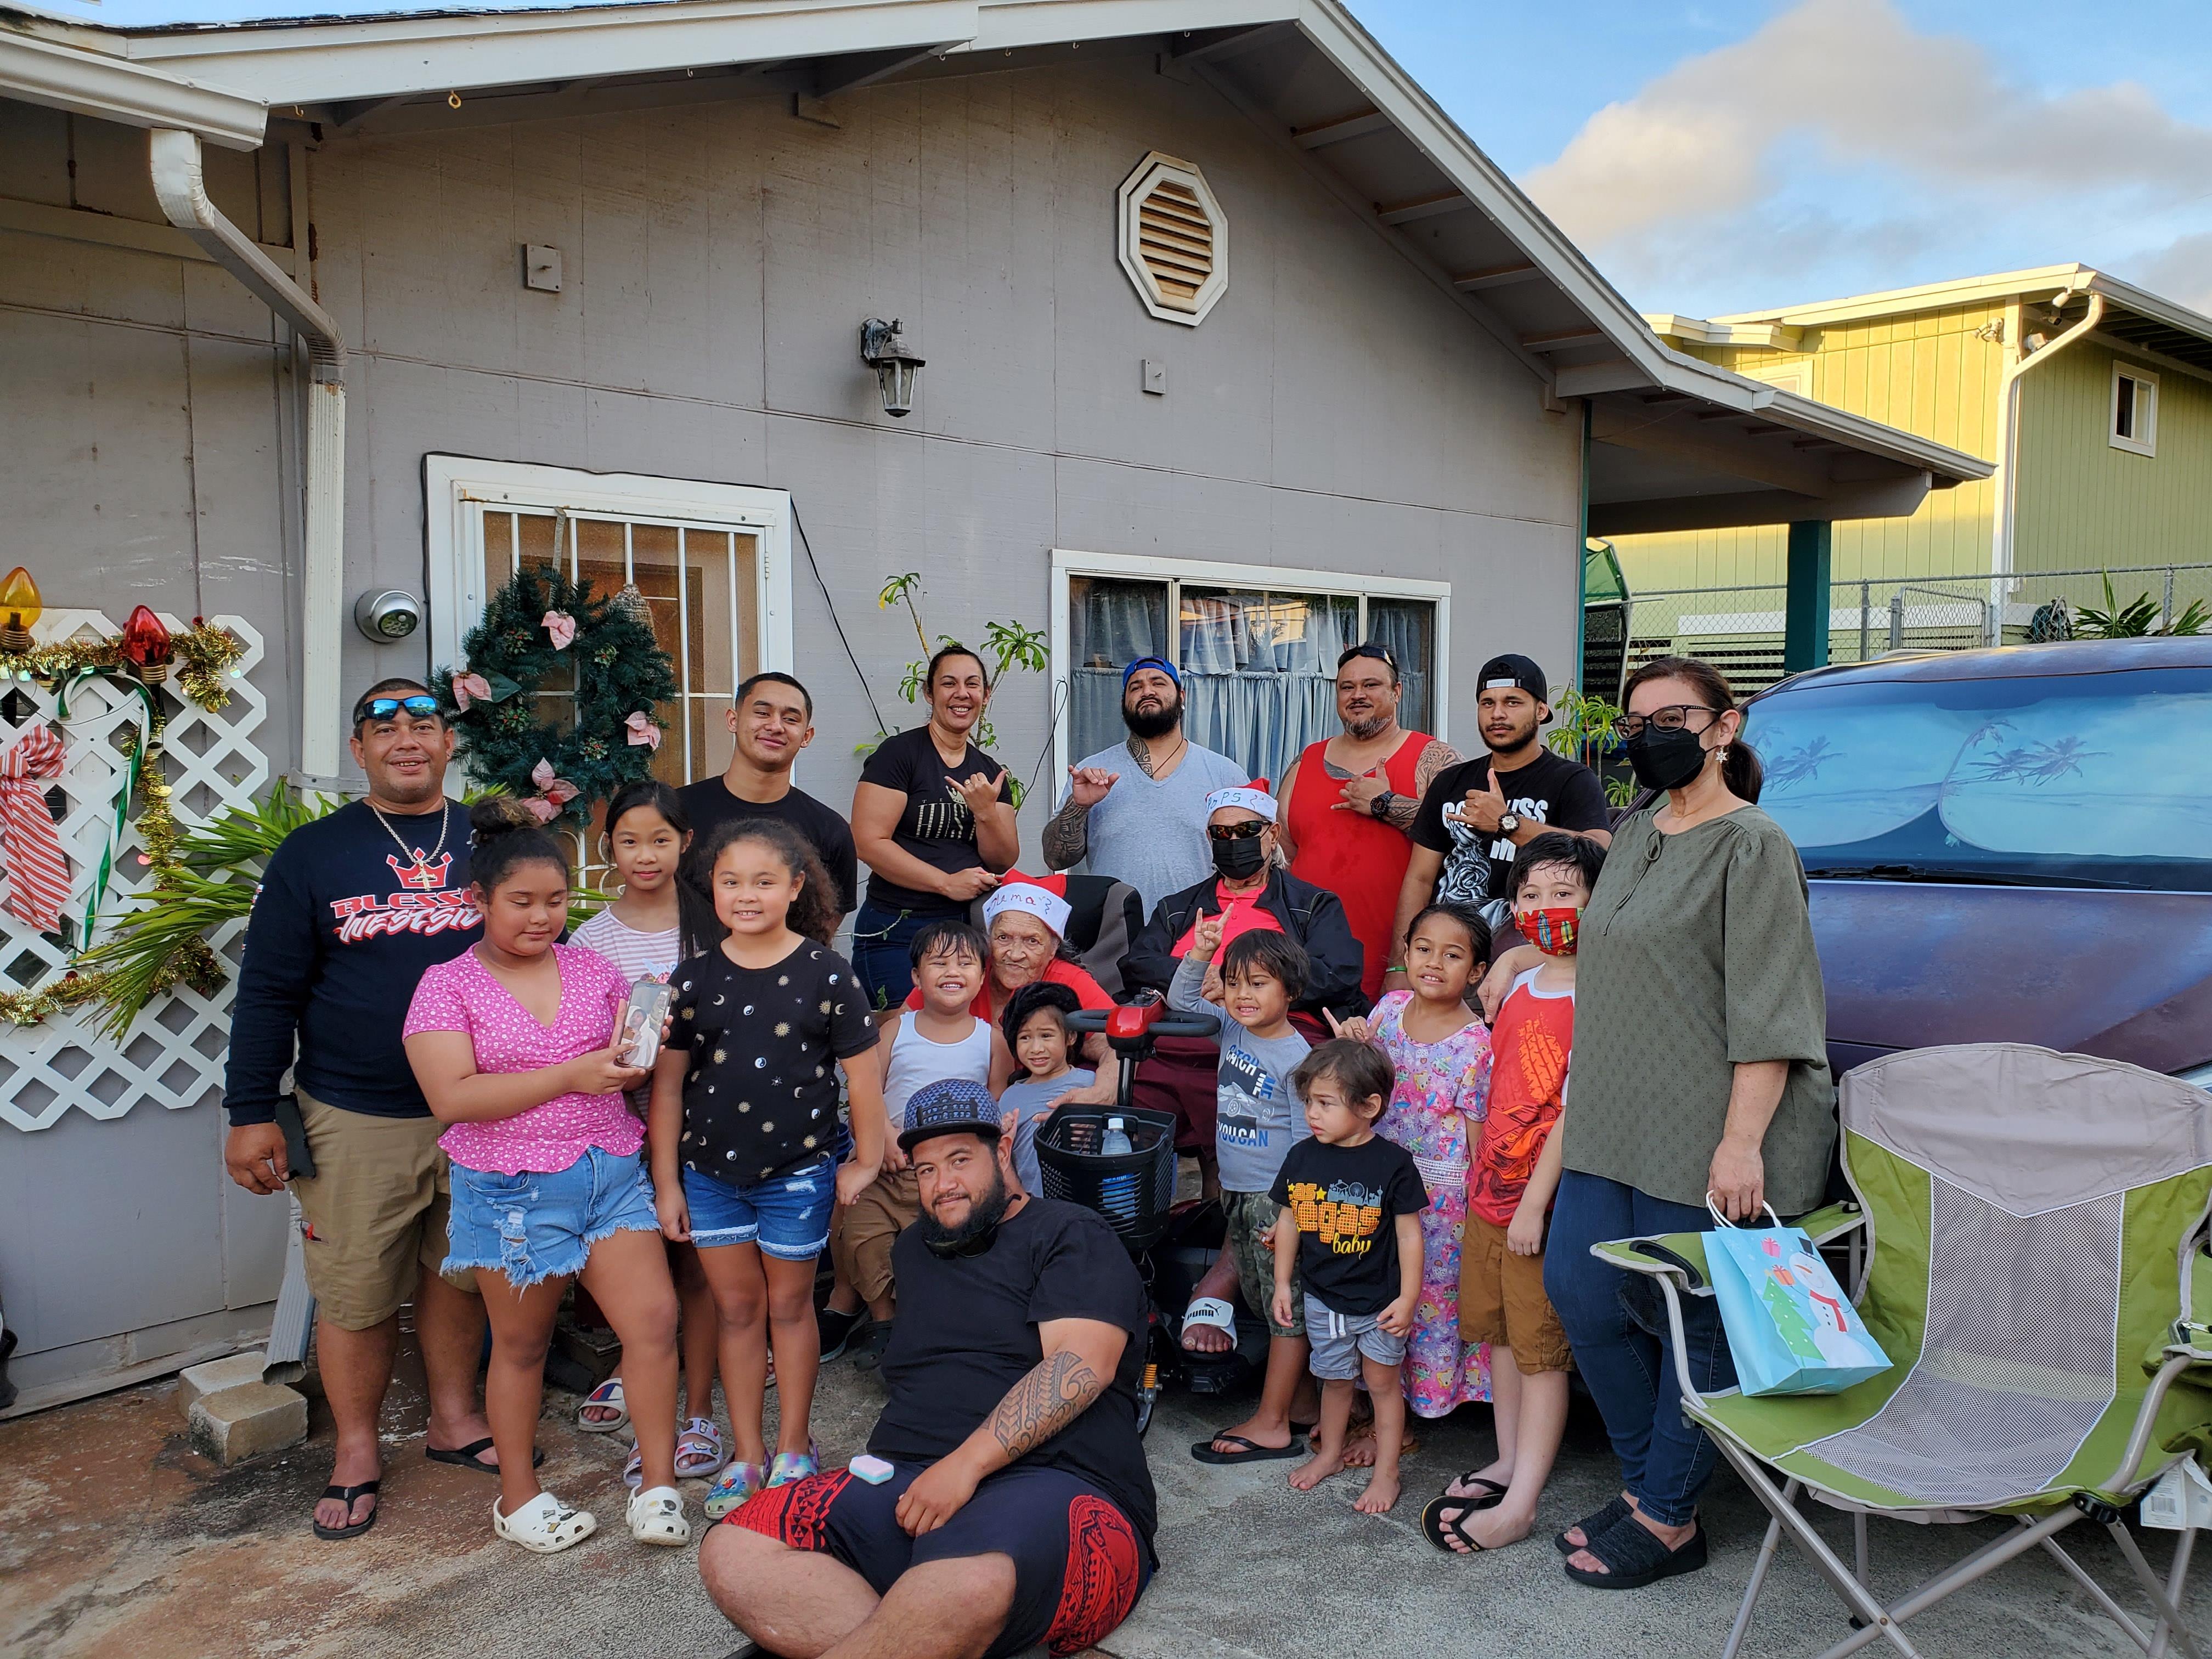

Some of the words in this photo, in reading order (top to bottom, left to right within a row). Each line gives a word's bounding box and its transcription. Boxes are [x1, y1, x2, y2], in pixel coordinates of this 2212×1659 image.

[1226, 1044, 1260, 1076] CATCH
[1252, 1073, 1277, 1100] ME
[1218, 1121, 1237, 1143] YOU
[1238, 1128, 1268, 1147] CAN
[1333, 1232, 1372, 1260] baby
[1187, 1309, 1214, 1321] PUMA
